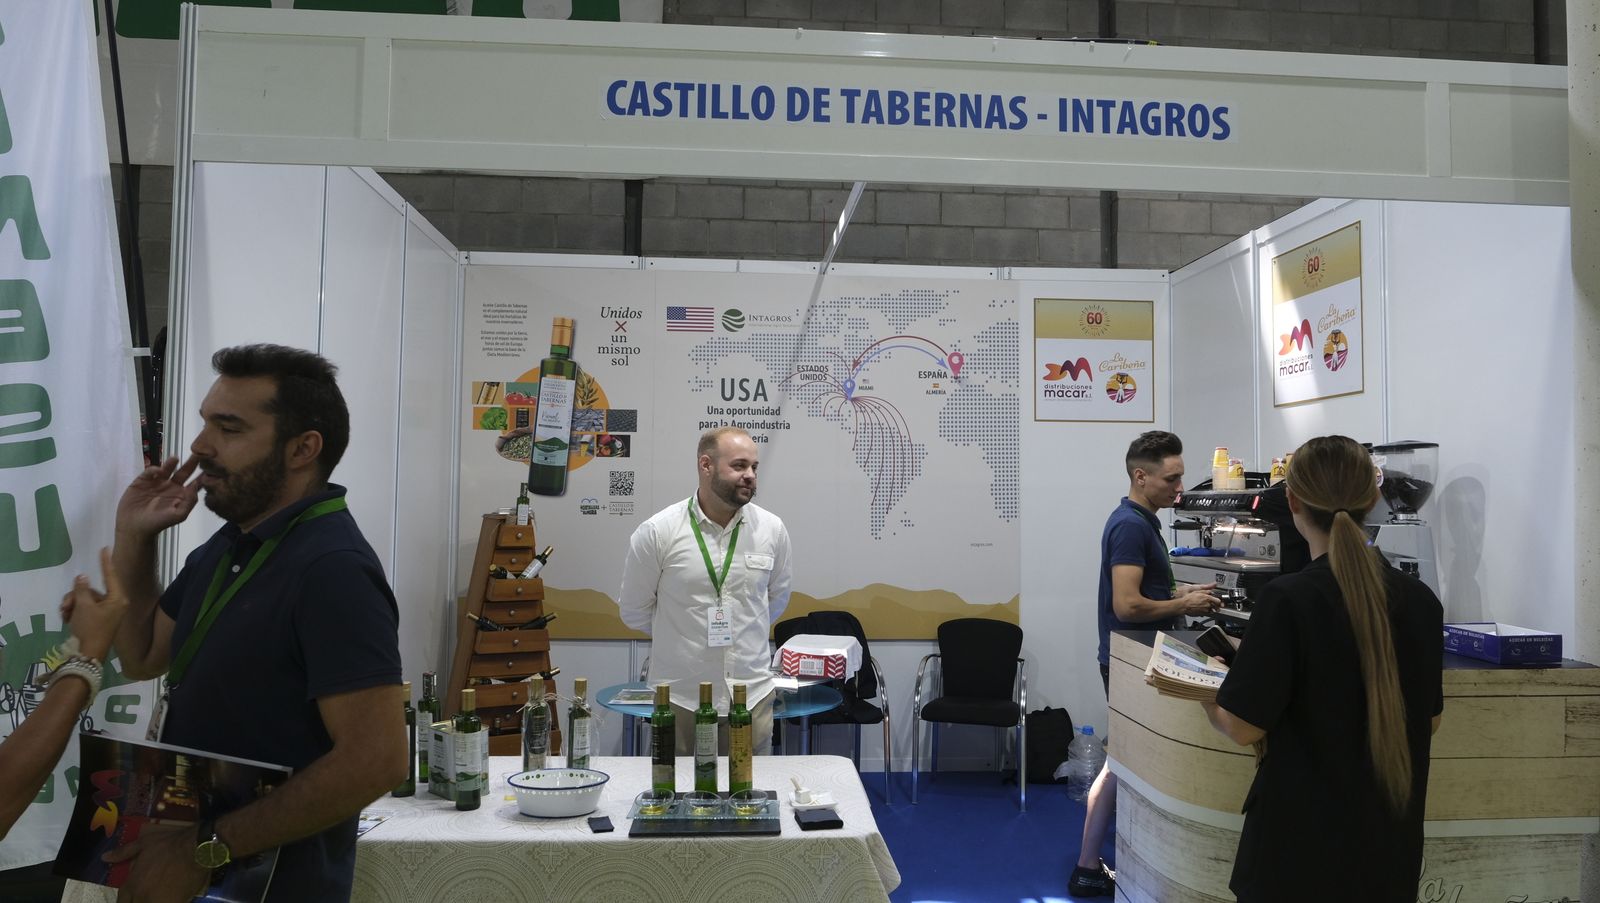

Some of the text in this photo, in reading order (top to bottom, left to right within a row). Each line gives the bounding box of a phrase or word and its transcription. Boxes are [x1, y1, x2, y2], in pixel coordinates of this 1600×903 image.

[606, 79, 775, 121] CASTILLO
[786, 87, 830, 122] DE
[841, 88, 1028, 130] TABERNAS
[1059, 98, 1231, 140] INTAGROS
[1307, 255, 1320, 274] 60
[601, 306, 642, 319] Unidos
[748, 314, 792, 322] INTAGROS
[1086, 312, 1102, 325] 60
[1317, 308, 1356, 334] Caribeña
[598, 344, 640, 354] mismo
[611, 355, 629, 366] sol
[1098, 359, 1146, 372] Caribeña
[1280, 354, 1313, 367] distribuciones
[918, 369, 948, 379] ESPAÑA
[1280, 360, 1309, 377] macar
[720, 378, 768, 402] USA
[1044, 389, 1086, 398] macar
[707, 406, 781, 417] Una oportunidad
[699, 420, 719, 430] para
[731, 420, 790, 430] Agroindustria
[752, 434, 768, 443] ería
